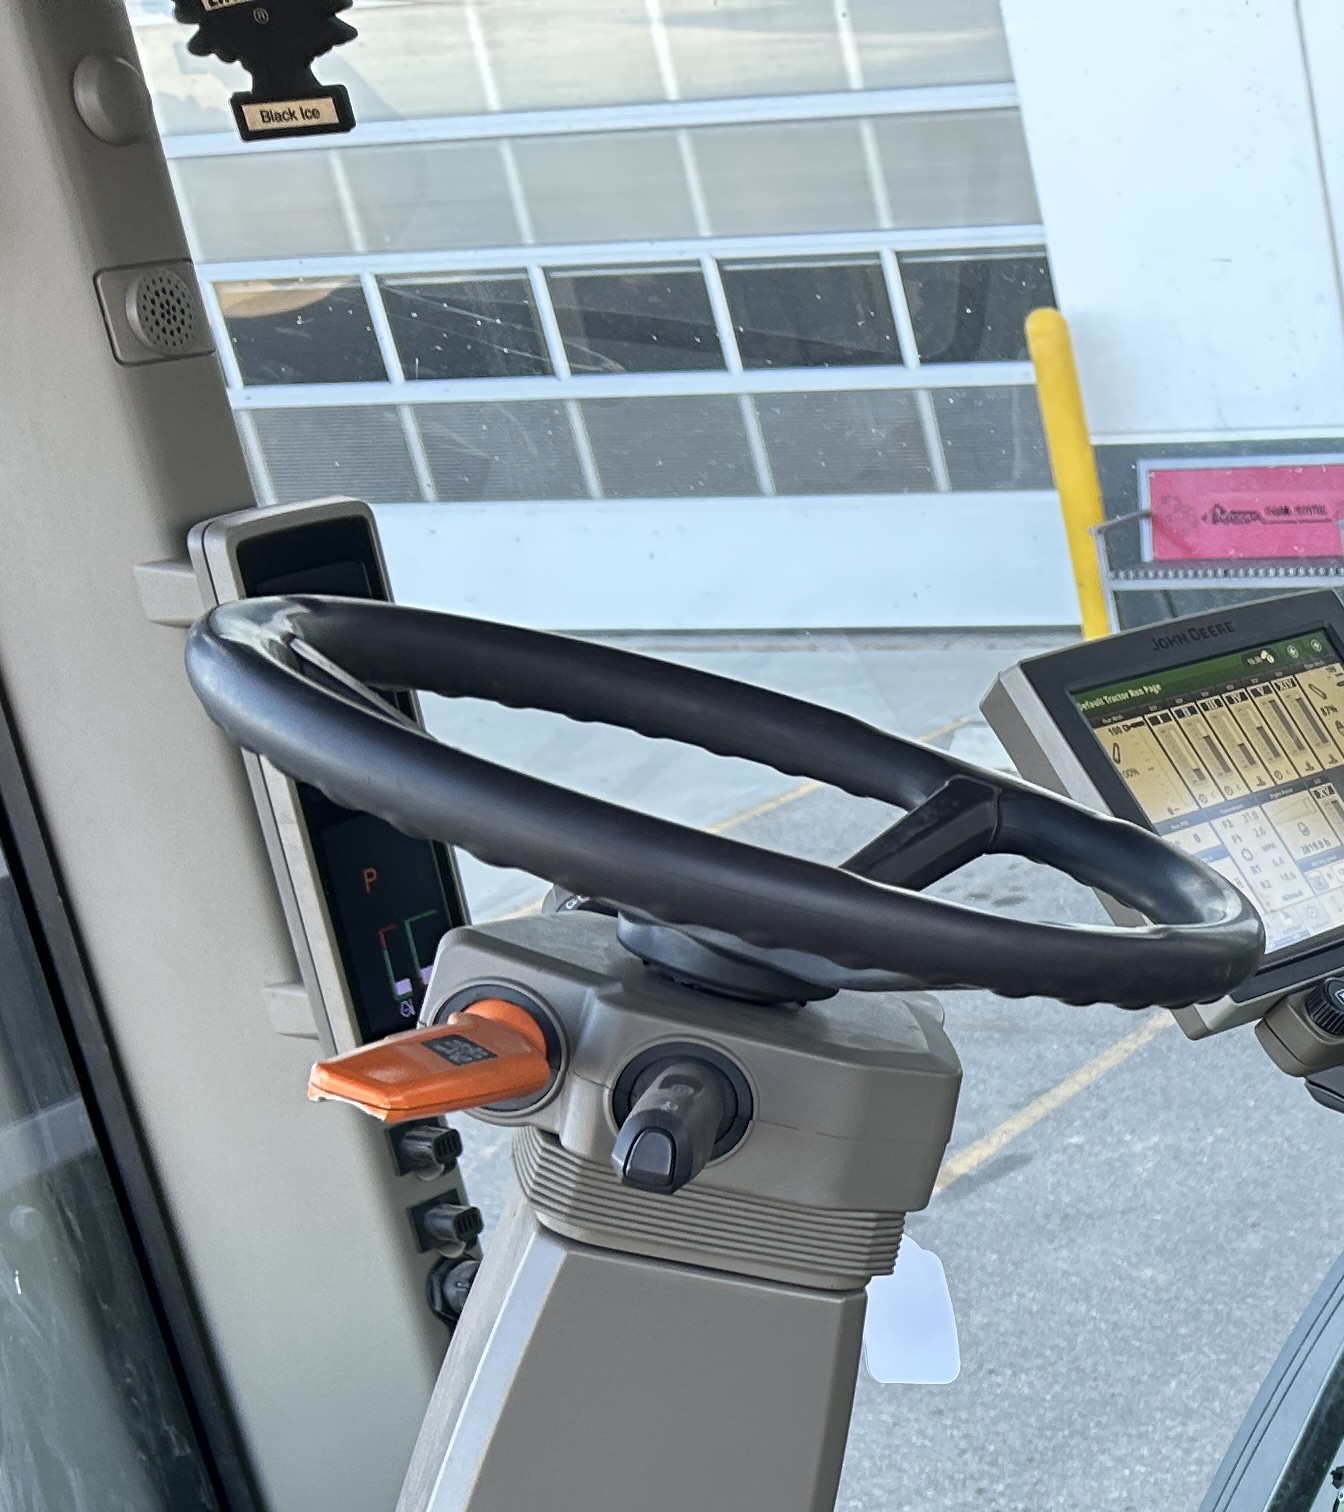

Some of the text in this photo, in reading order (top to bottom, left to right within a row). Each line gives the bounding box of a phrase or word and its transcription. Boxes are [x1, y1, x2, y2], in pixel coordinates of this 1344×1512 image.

[259, 106, 321, 123] Black Ice
[1151, 621, 1236, 652] JOHN DEERE
[1103, 692, 1129, 704] Tractor
[1127, 688, 1145, 698] Run
[1143, 684, 1161, 694] Page
[363, 867, 377, 894] P
